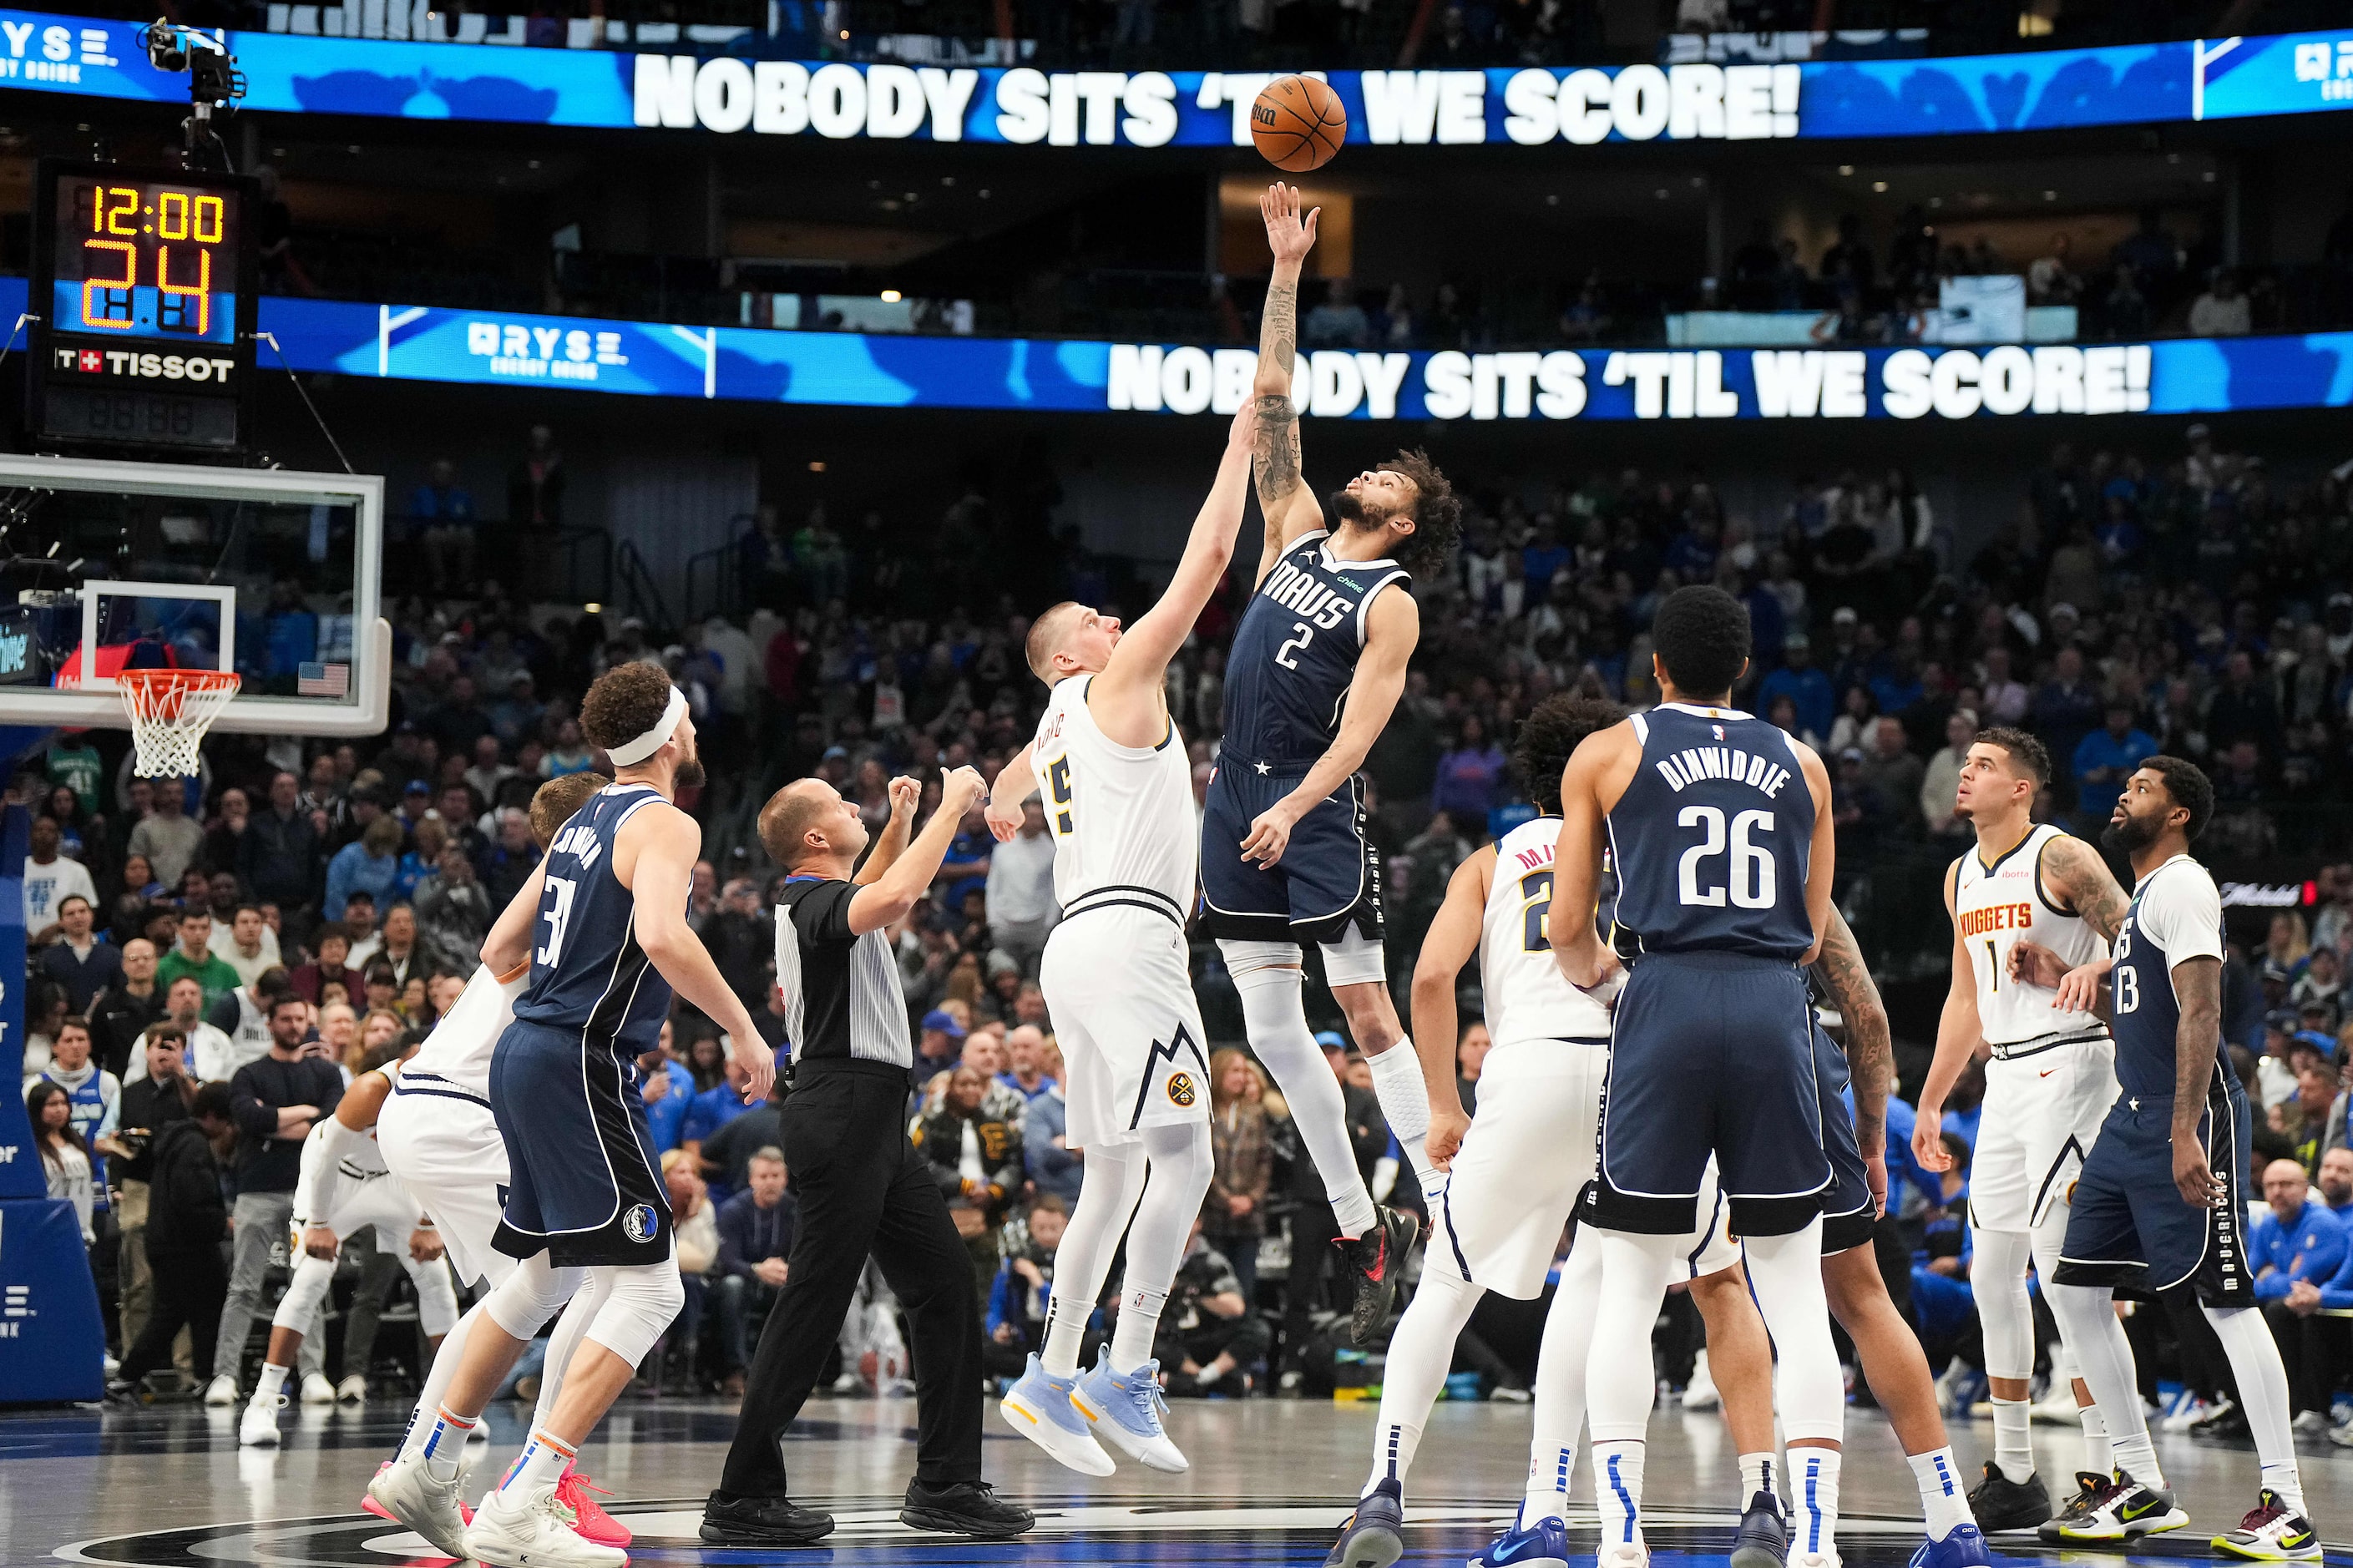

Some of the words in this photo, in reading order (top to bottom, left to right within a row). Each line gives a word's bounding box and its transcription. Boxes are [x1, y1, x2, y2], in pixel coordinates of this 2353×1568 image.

[634, 53, 978, 141] NOBODY
[996, 68, 1177, 147] SITS
[1361, 70, 1486, 144] WE
[1504, 64, 1800, 145] SCORE!
[94, 185, 224, 244] 12:00
[83, 239, 210, 336] 24
[105, 351, 235, 382] TISSOT
[503, 325, 622, 366] RYSE
[1424, 351, 1587, 419] SITS
[1752, 351, 1867, 417] WE
[1882, 346, 2152, 419] SCORE!
[1262, 559, 1355, 630] MAVS
[1337, 576, 1364, 594] chime
[1275, 622, 1313, 670] 2
[1656, 746, 1792, 800] DINWIDDIE
[1678, 806, 1776, 909] 26
[2002, 870, 2029, 878] ibotta
[537, 875, 577, 969] 31
[1960, 903, 2032, 938] NUGGETS
[1985, 939, 1998, 993] 1
[2117, 965, 2139, 1014] 13
